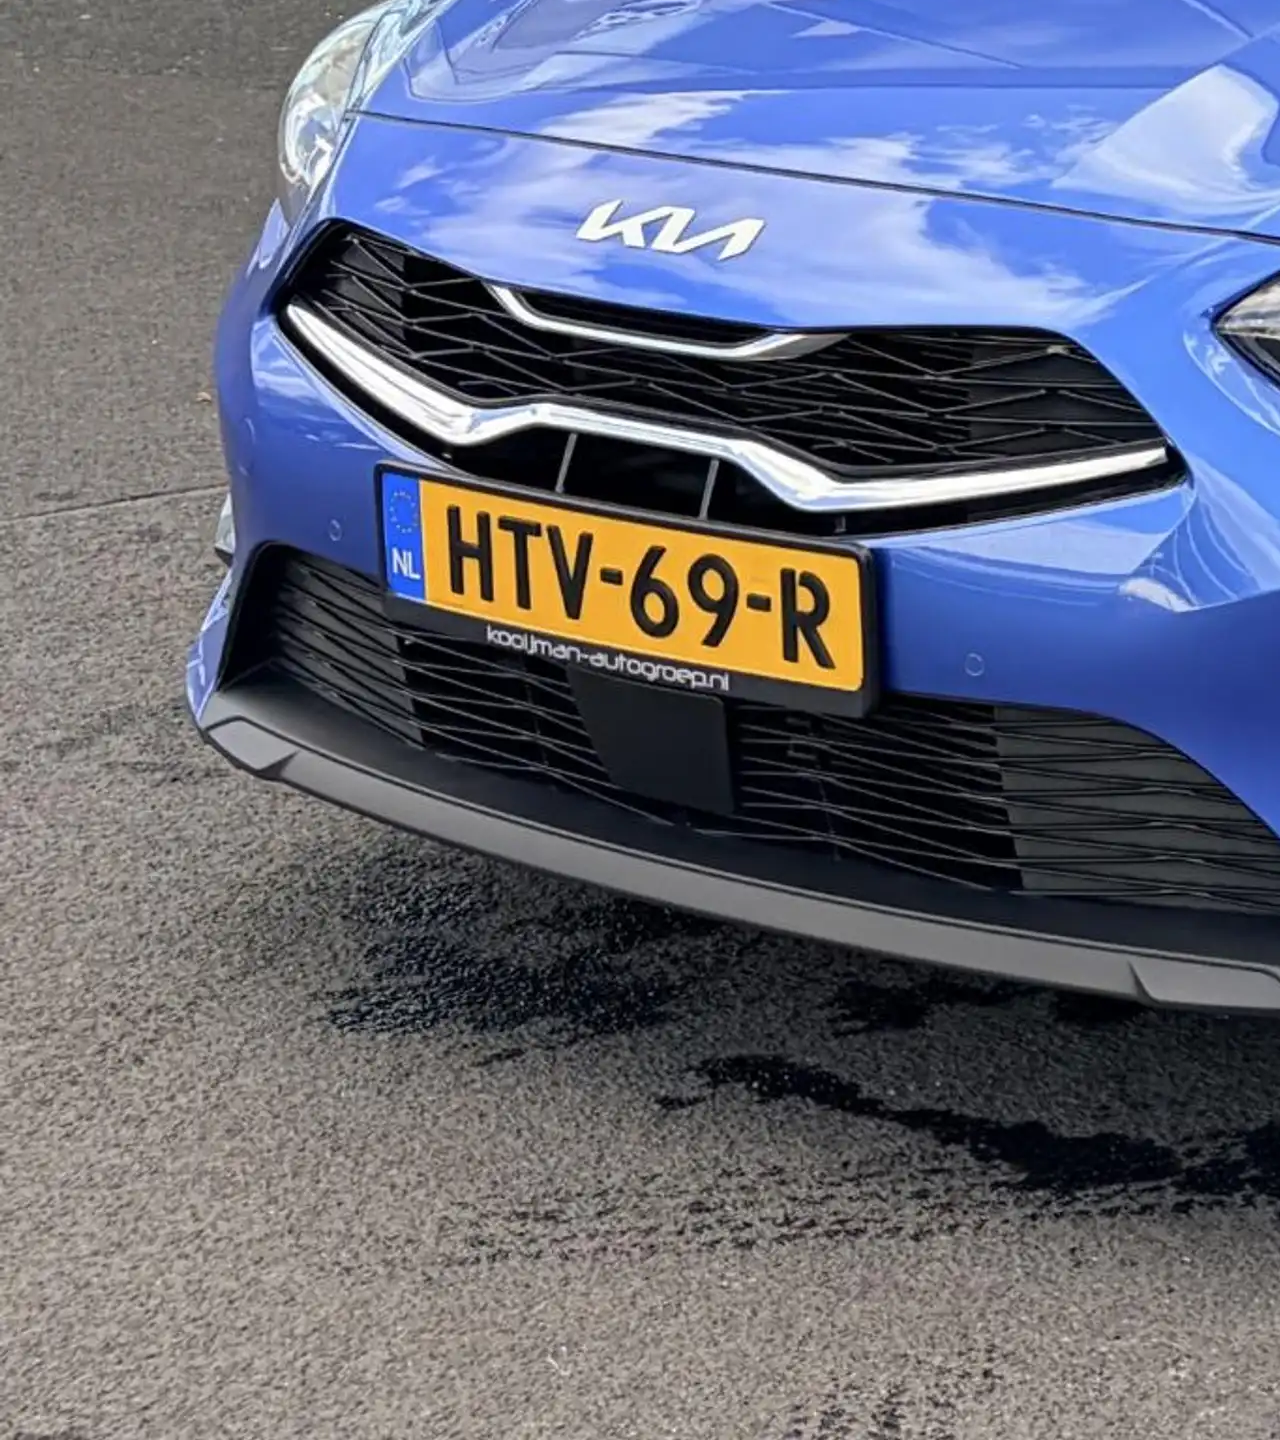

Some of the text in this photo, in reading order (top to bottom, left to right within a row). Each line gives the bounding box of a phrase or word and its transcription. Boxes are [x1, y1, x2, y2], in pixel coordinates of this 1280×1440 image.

[576, 198, 766, 261] KIA
[391, 547, 422, 582] NL
[446, 503, 835, 670] HTV-69-R
[486, 625, 730, 692] kooijman-autogroep.nl
